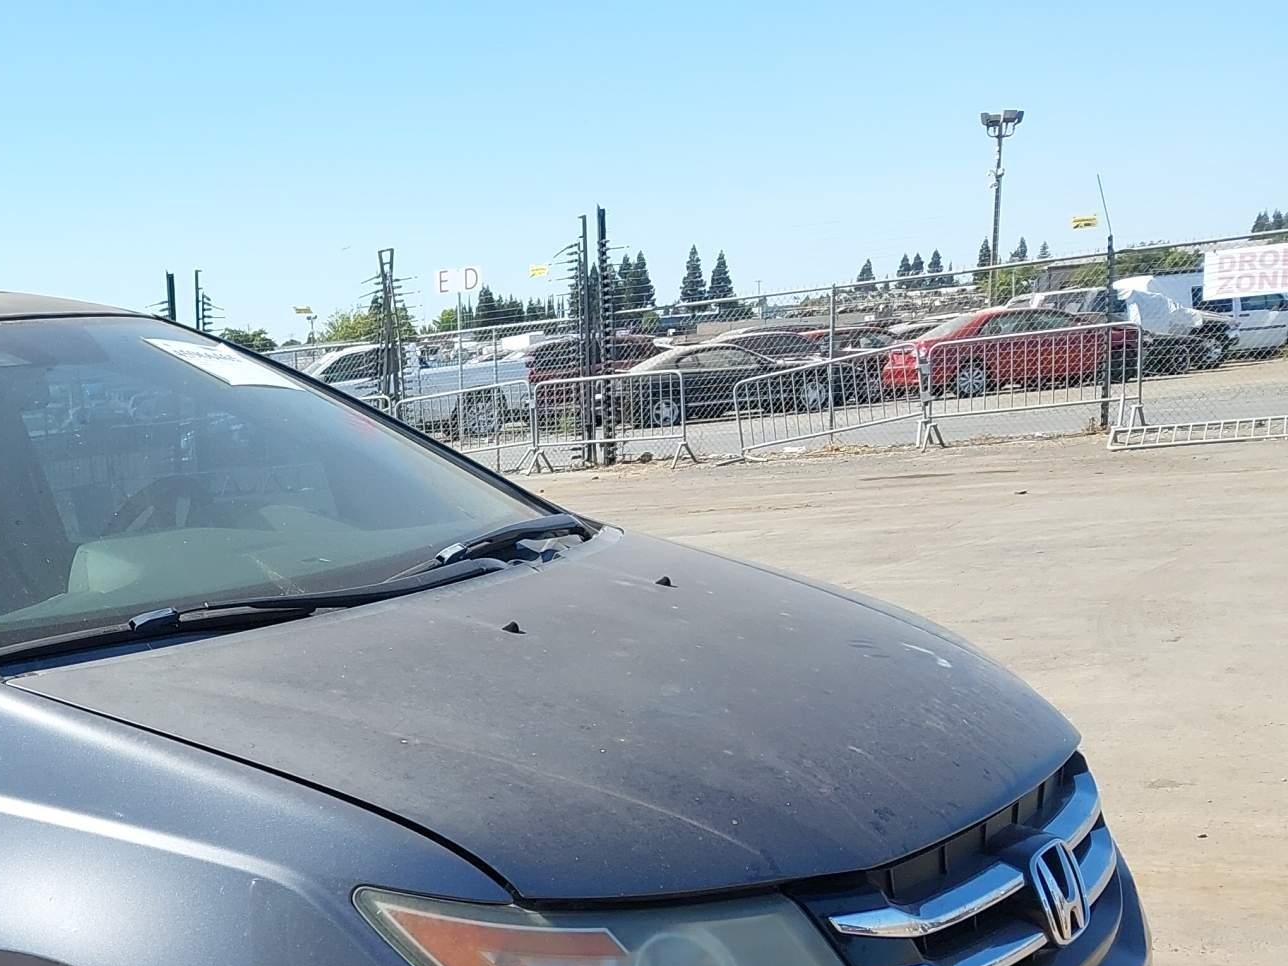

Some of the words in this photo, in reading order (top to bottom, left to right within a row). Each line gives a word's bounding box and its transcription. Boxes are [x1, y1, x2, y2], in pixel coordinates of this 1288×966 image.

[1218, 248, 1288, 272] DRO
[463, 267, 479, 291] D
[1218, 269, 1288, 295] ZON
